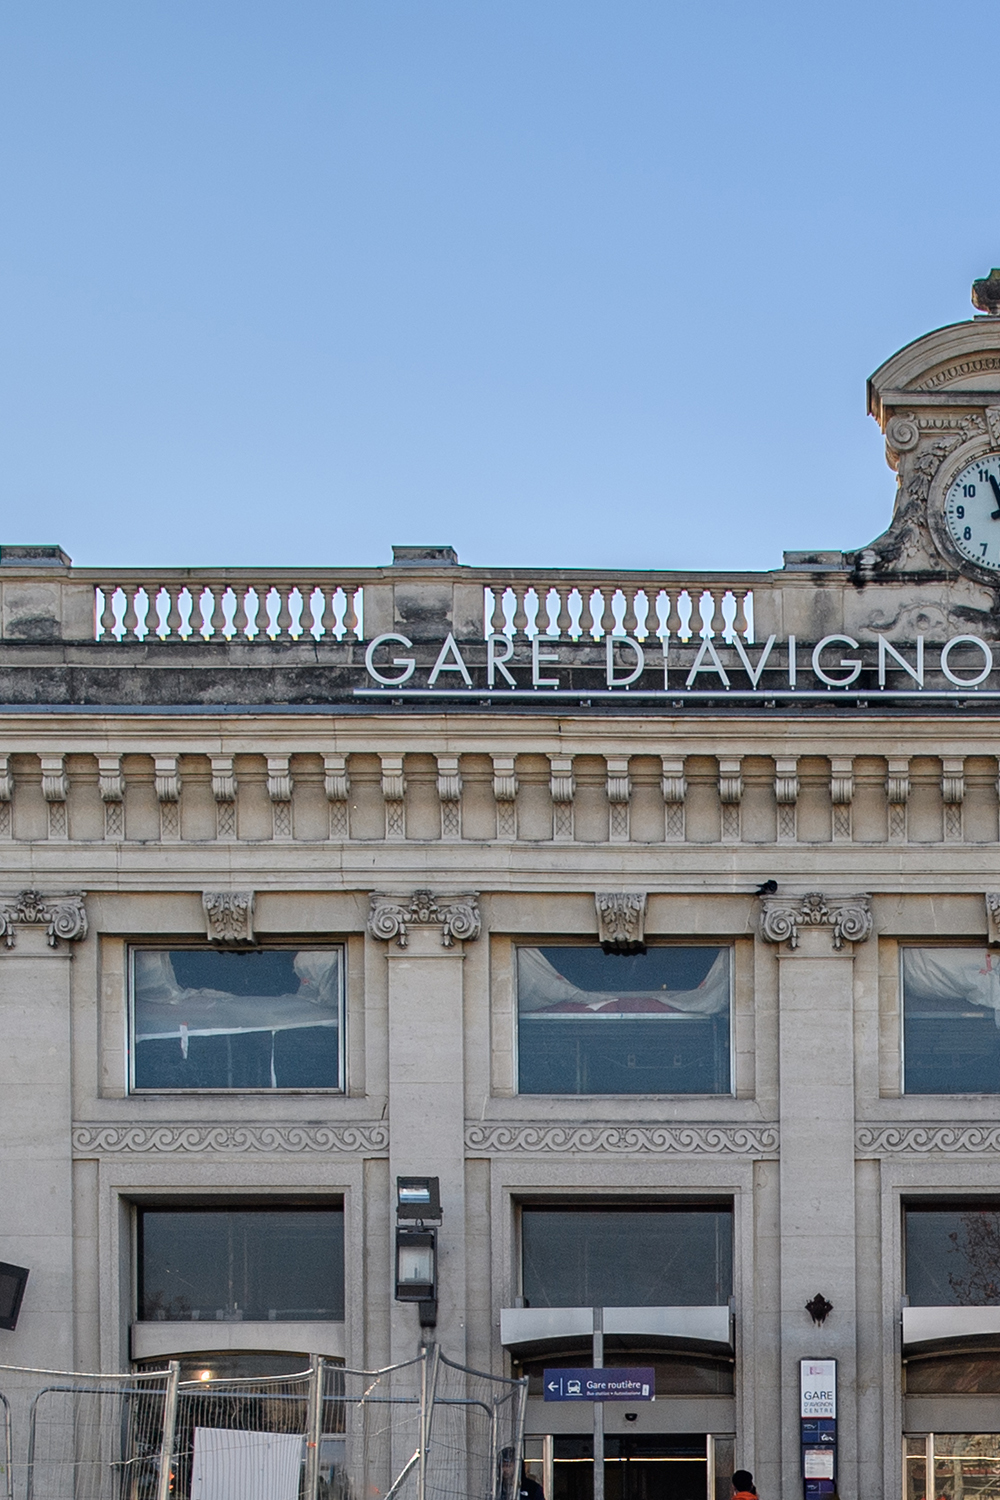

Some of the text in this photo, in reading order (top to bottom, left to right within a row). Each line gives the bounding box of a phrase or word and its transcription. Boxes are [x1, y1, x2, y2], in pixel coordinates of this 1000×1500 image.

[978, 469, 989, 482] 11
[962, 484, 976, 497] 10
[956, 506, 965, 519] 9
[963, 526, 972, 541] 8
[979, 543, 988, 557] 7
[364, 633, 561, 687] GARE
[586, 1380, 641, 1389] Gare routière
[804, 1391, 833, 1400] GARE
